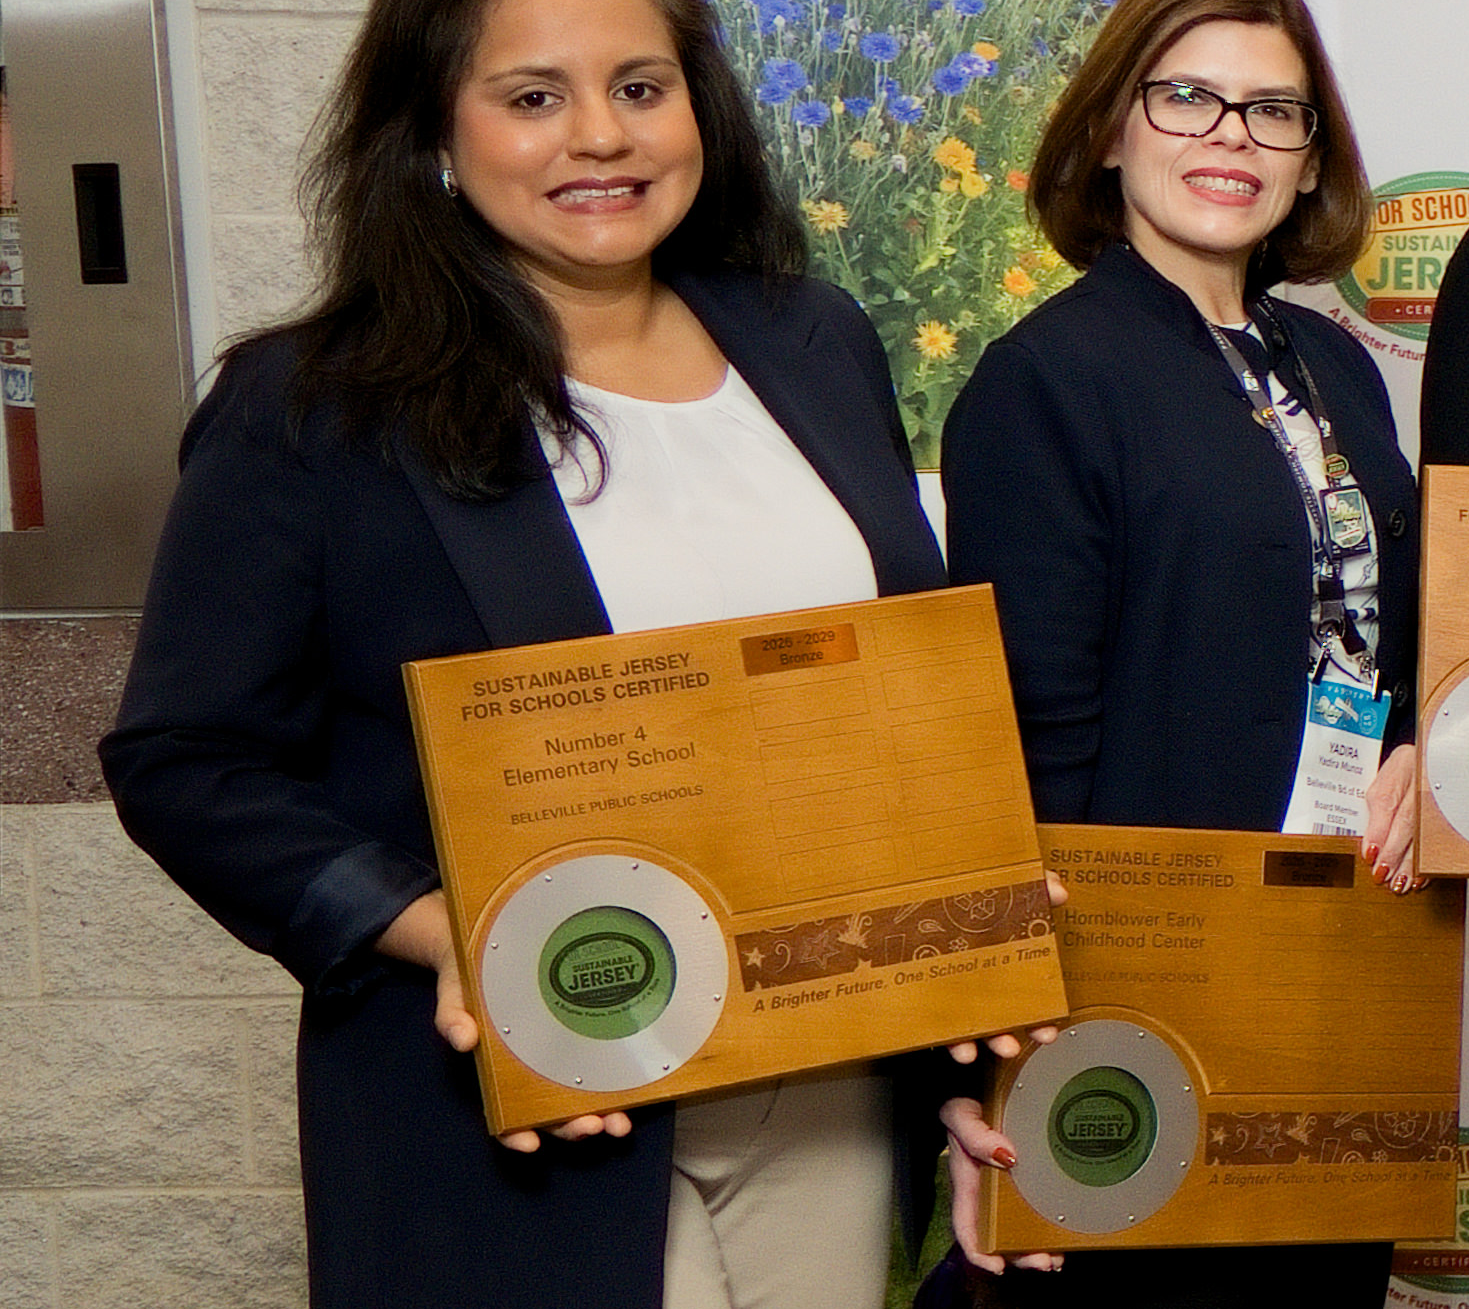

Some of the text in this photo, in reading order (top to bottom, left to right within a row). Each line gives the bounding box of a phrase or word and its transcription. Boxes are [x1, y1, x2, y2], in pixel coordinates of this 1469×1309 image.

[471, 651, 692, 698] SUSTAINABLE JERSEY
[460, 670, 710, 722] FOR SCHOOLS CERTIFIED
[543, 725, 648, 756] Number 4
[1329, 742, 1359, 759] YADIRA
[502, 742, 695, 788] Elementary School
[1065, 911, 1205, 929] Hornblower Early
[1063, 932, 1205, 948] Childhood Center
